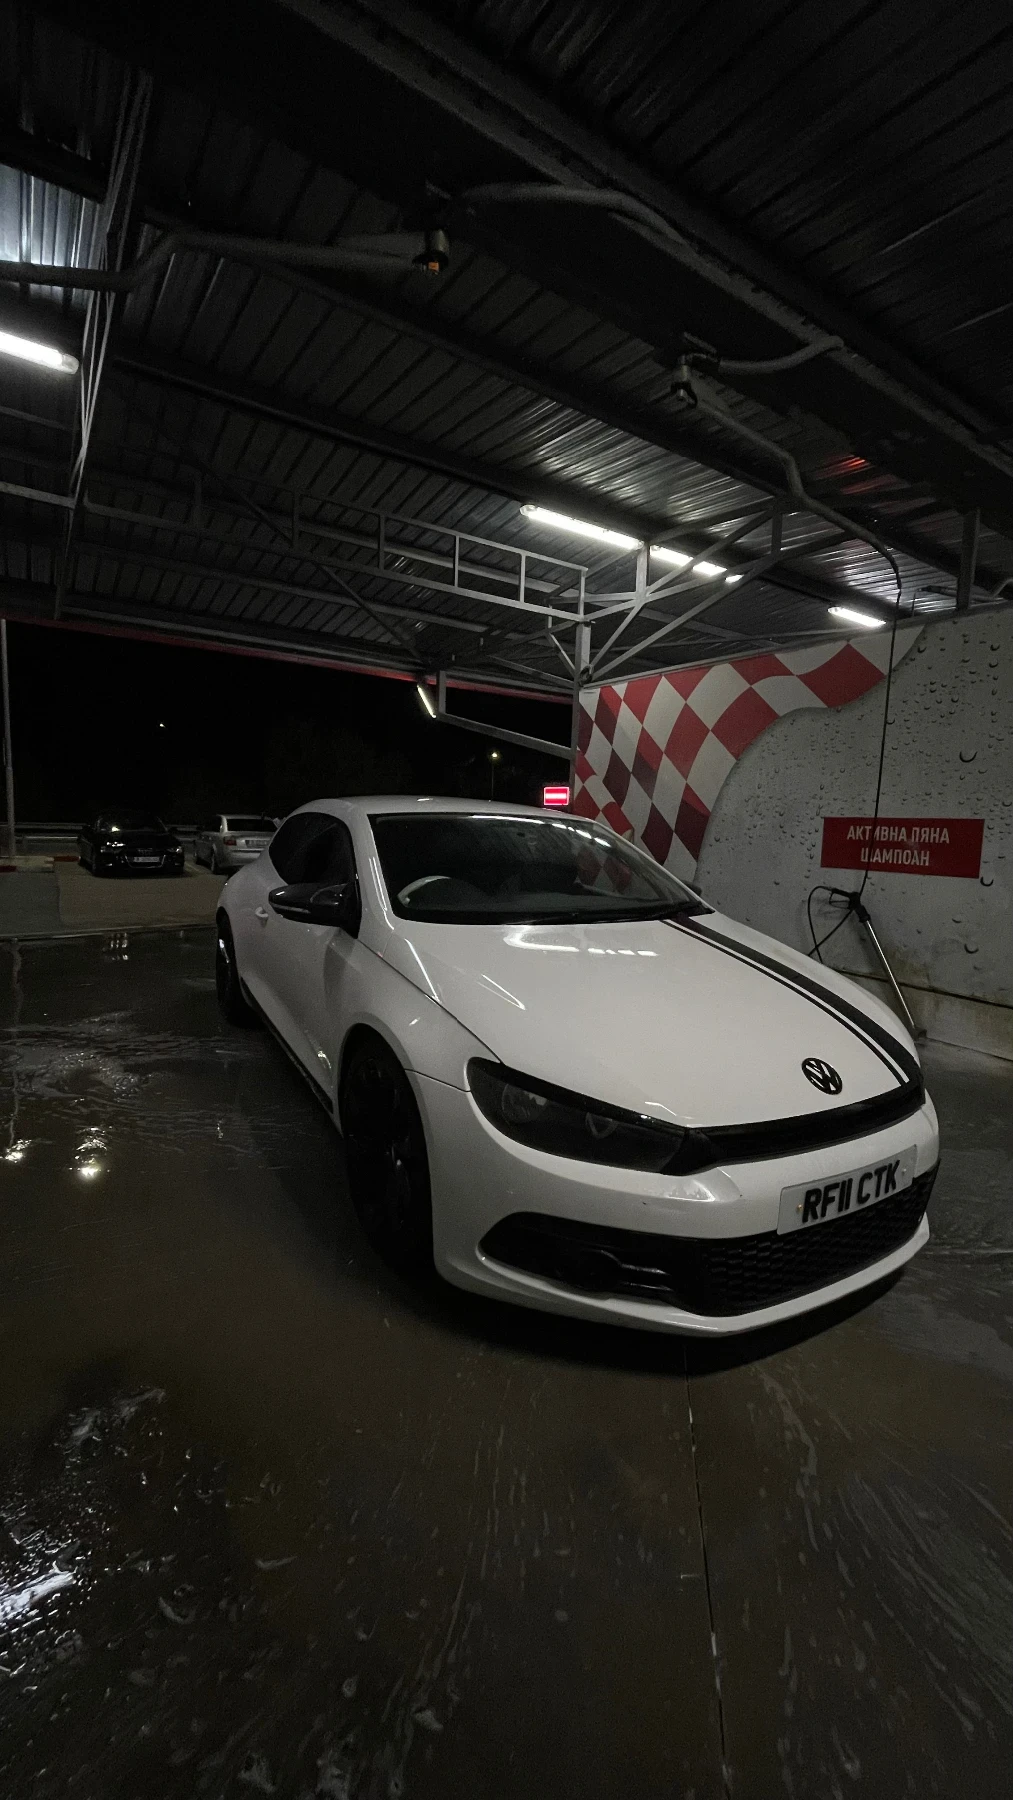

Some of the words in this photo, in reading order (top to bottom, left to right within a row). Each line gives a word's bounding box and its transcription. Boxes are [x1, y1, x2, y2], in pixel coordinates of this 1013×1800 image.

[846, 825, 907, 842] АКТИВНА
[911, 827, 950, 844] ПЯНА
[801, 1057, 843, 1095] VW
[802, 1178, 853, 1223] RF11
[857, 1159, 901, 1205] CTK
